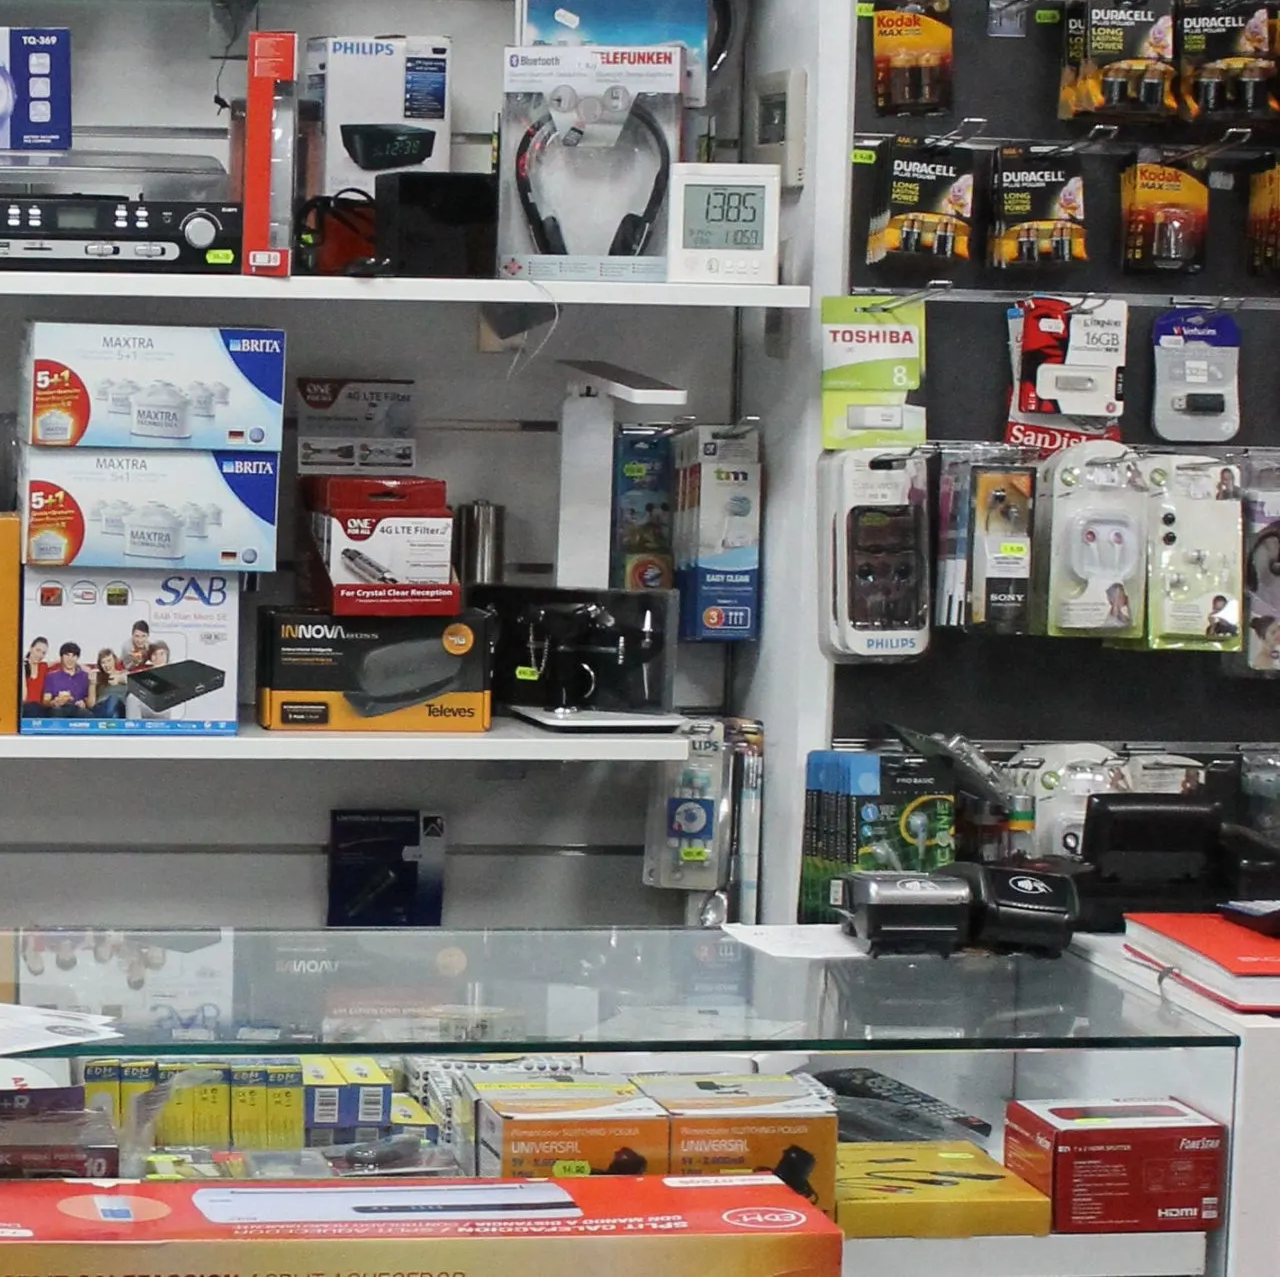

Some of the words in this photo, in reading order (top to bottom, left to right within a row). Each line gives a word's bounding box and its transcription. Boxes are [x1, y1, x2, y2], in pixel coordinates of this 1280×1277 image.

[877, 14, 923, 28] Kodak
[1091, 9, 1155, 22] DURACELL
[1184, 16, 1246, 29] DURACELL
[1091, 27, 1123, 36] LONG
[22, 36, 58, 46] TQ-369
[1091, 41, 1124, 51] POWER
[331, 41, 395, 58] PHILIPS
[520, 55, 561, 67] Bluetooth
[893, 159, 956, 177] DURACELL
[1002, 171, 1065, 183] DURACELL
[1139, 169, 1182, 183] Kodak
[893, 181, 919, 191] LONG
[892, 193, 919, 203] POWER
[1004, 192, 1031, 200] LONG
[1004, 204, 1031, 212] POWER
[102, 337, 154, 349] MAXTRA
[829, 329, 914, 344] TOSHIBA
[1085, 332, 1120, 346] 16GB
[241, 339, 281, 353] BRITA
[364, 391, 382, 401] LTE
[384, 392, 412, 402] Filter
[137, 410, 178, 421] MAXTRA
[96, 458, 148, 471] MAXTRA
[234, 461, 274, 474] BRITA
[347, 518, 371, 529] ONE
[130, 531, 171, 543] MAXTRA
[379, 526, 393, 535] 4G
[395, 526, 412, 535] LTE
[414, 526, 440, 535] Filter
[156, 575, 228, 607] SAB
[356, 589, 386, 598] Crystal
[410, 589, 453, 598] Reception
[990, 593, 1025, 602] SONY
[710, 609, 719, 626] 3
[281, 624, 346, 639] INNOVA
[866, 637, 917, 650] PHILIPS
[424, 703, 476, 718] Televes
[511, 1140, 582, 1153] UNIVERSAL
[681, 1139, 750, 1152] UNIVERSAL
[84, 1157, 107, 1174] 10
[1157, 1208, 1198, 1219] HDMI
